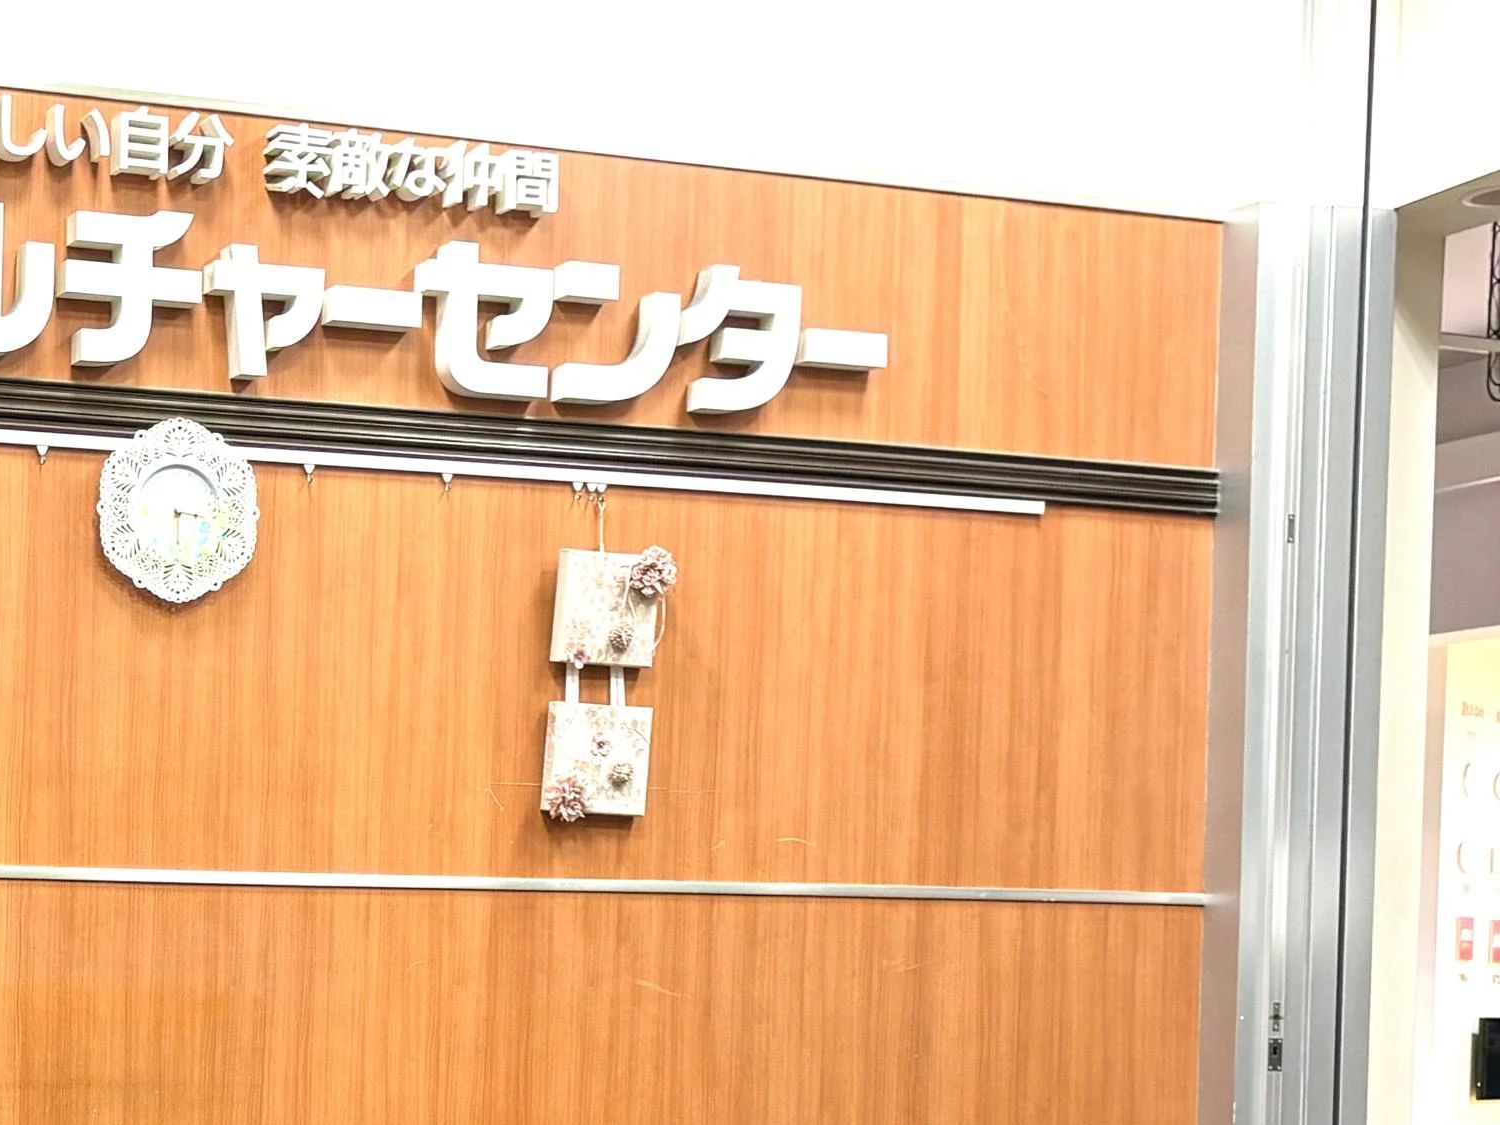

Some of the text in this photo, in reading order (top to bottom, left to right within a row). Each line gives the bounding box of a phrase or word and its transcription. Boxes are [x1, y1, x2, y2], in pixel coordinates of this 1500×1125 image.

[263, 124, 561, 217] 素敵な仲間
